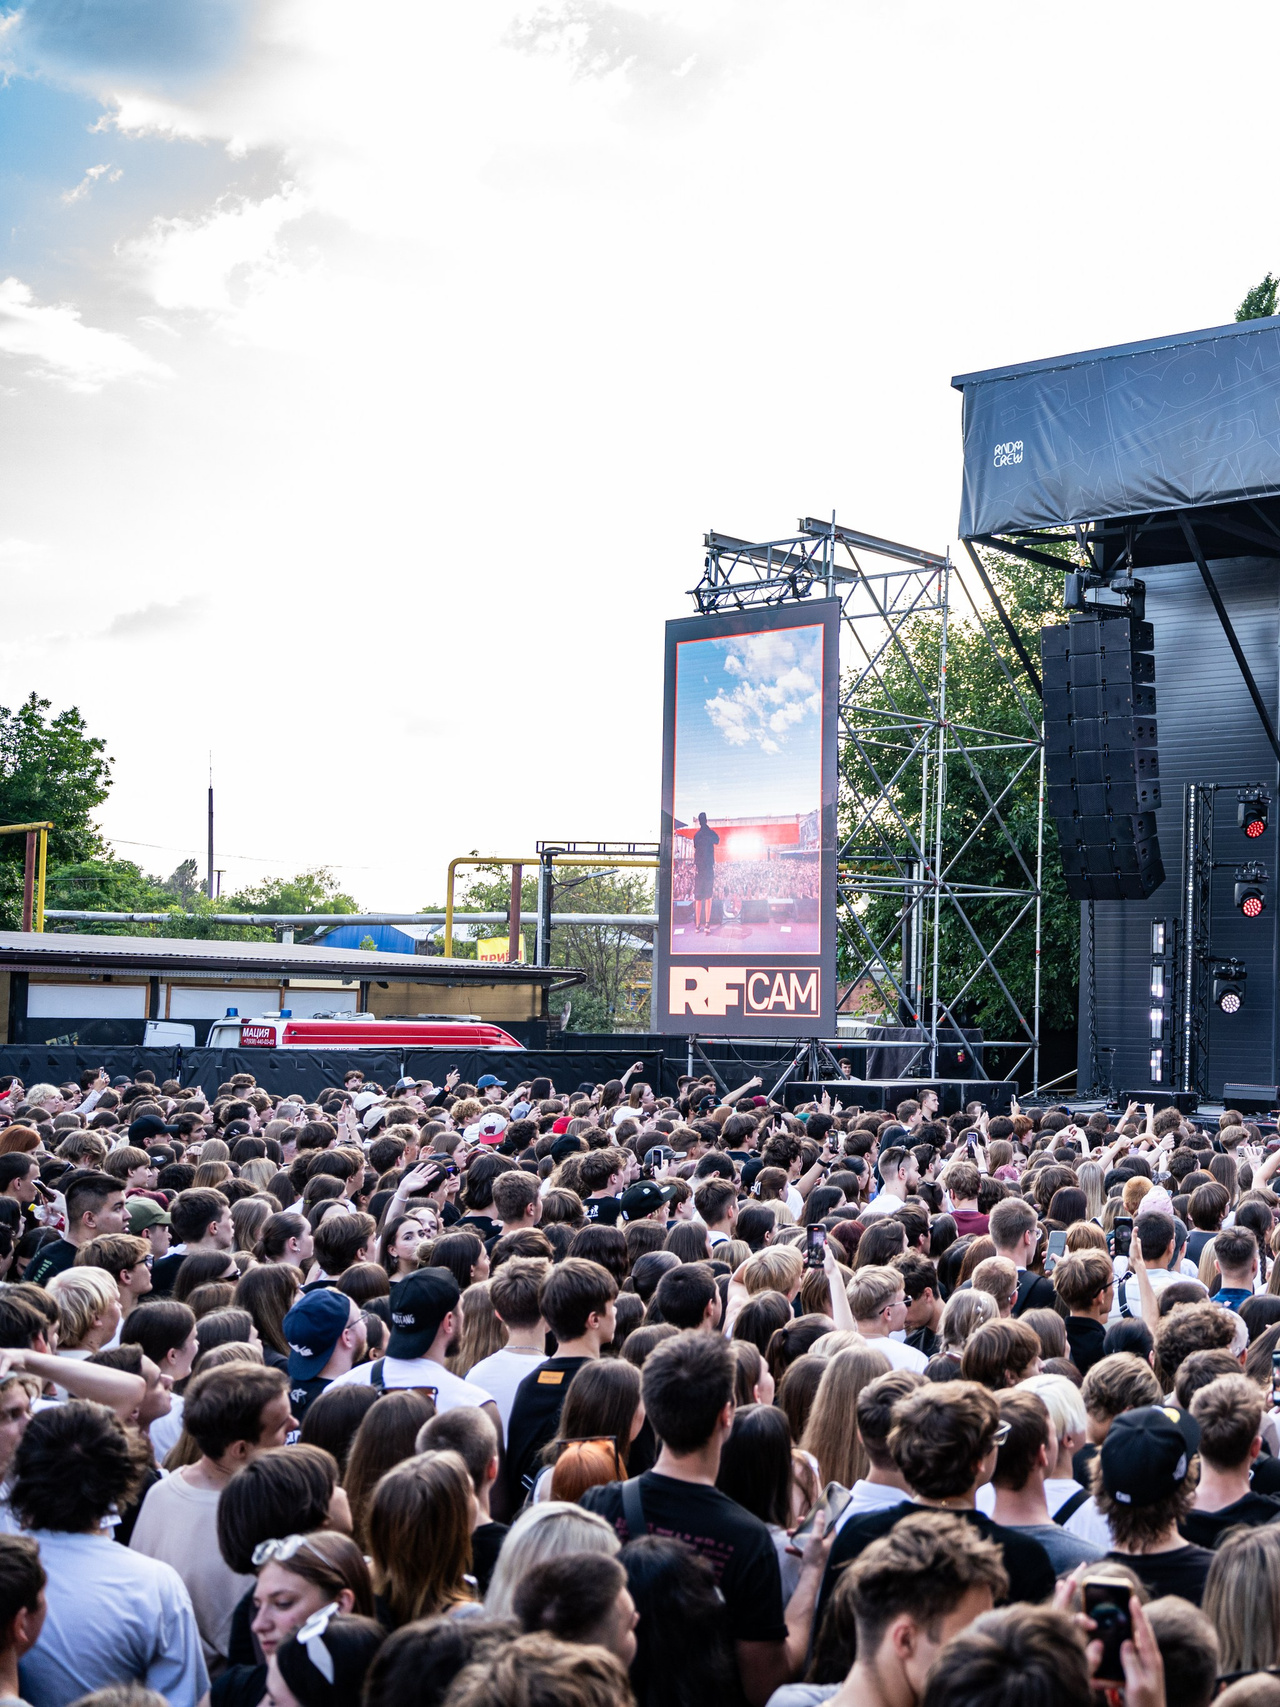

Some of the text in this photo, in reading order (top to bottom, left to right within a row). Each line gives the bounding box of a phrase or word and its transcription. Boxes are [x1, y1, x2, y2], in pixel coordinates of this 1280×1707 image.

[993, 451, 1023, 468] CREW
[669, 966, 817, 1015] RF CAM
[242, 1027, 269, 1038] МАЦИЯ
